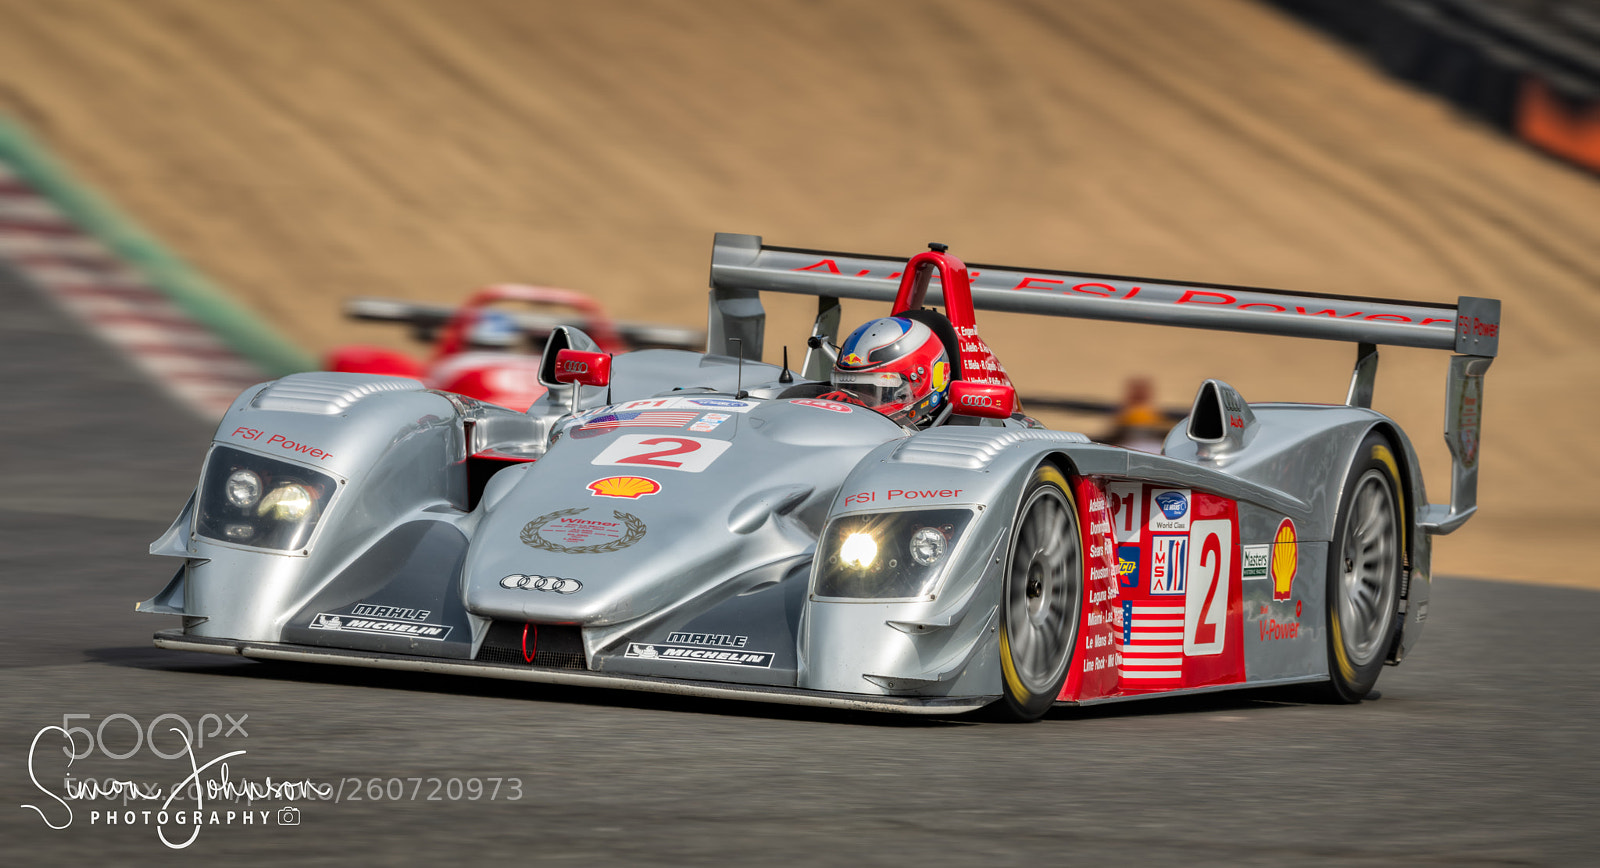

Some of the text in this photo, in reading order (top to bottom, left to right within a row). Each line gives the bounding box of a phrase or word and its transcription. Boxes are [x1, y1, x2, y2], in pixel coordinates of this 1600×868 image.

[1011, 277, 1141, 300] FSI
[1173, 289, 1453, 326] Power
[1457, 315, 1499, 338] FSI Power
[626, 400, 668, 409] P1
[231, 426, 334, 460] FSI Power
[614, 437, 702, 468] 2
[844, 489, 963, 507] FSI Power
[560, 517, 621, 528] Winner
[1174, 521, 1186, 529] Class
[1090, 545, 1104, 558] Sears
[1244, 551, 1268, 567] Masters
[1153, 540, 1166, 591] IMSA
[1193, 532, 1222, 645] 2
[1089, 590, 1107, 606] Laguna
[352, 603, 432, 622] MAHLE
[1088, 611, 1103, 626] Miami
[1105, 610, 1113, 623] Las
[346, 619, 443, 636] MICHELIN
[1259, 619, 1300, 641] V-Power
[666, 631, 748, 648] MAHLE
[1086, 636, 1094, 650] Le
[1095, 633, 1107, 648] Mans
[663, 648, 765, 664] MICHELIN
[1083, 659, 1094, 673] Lime
